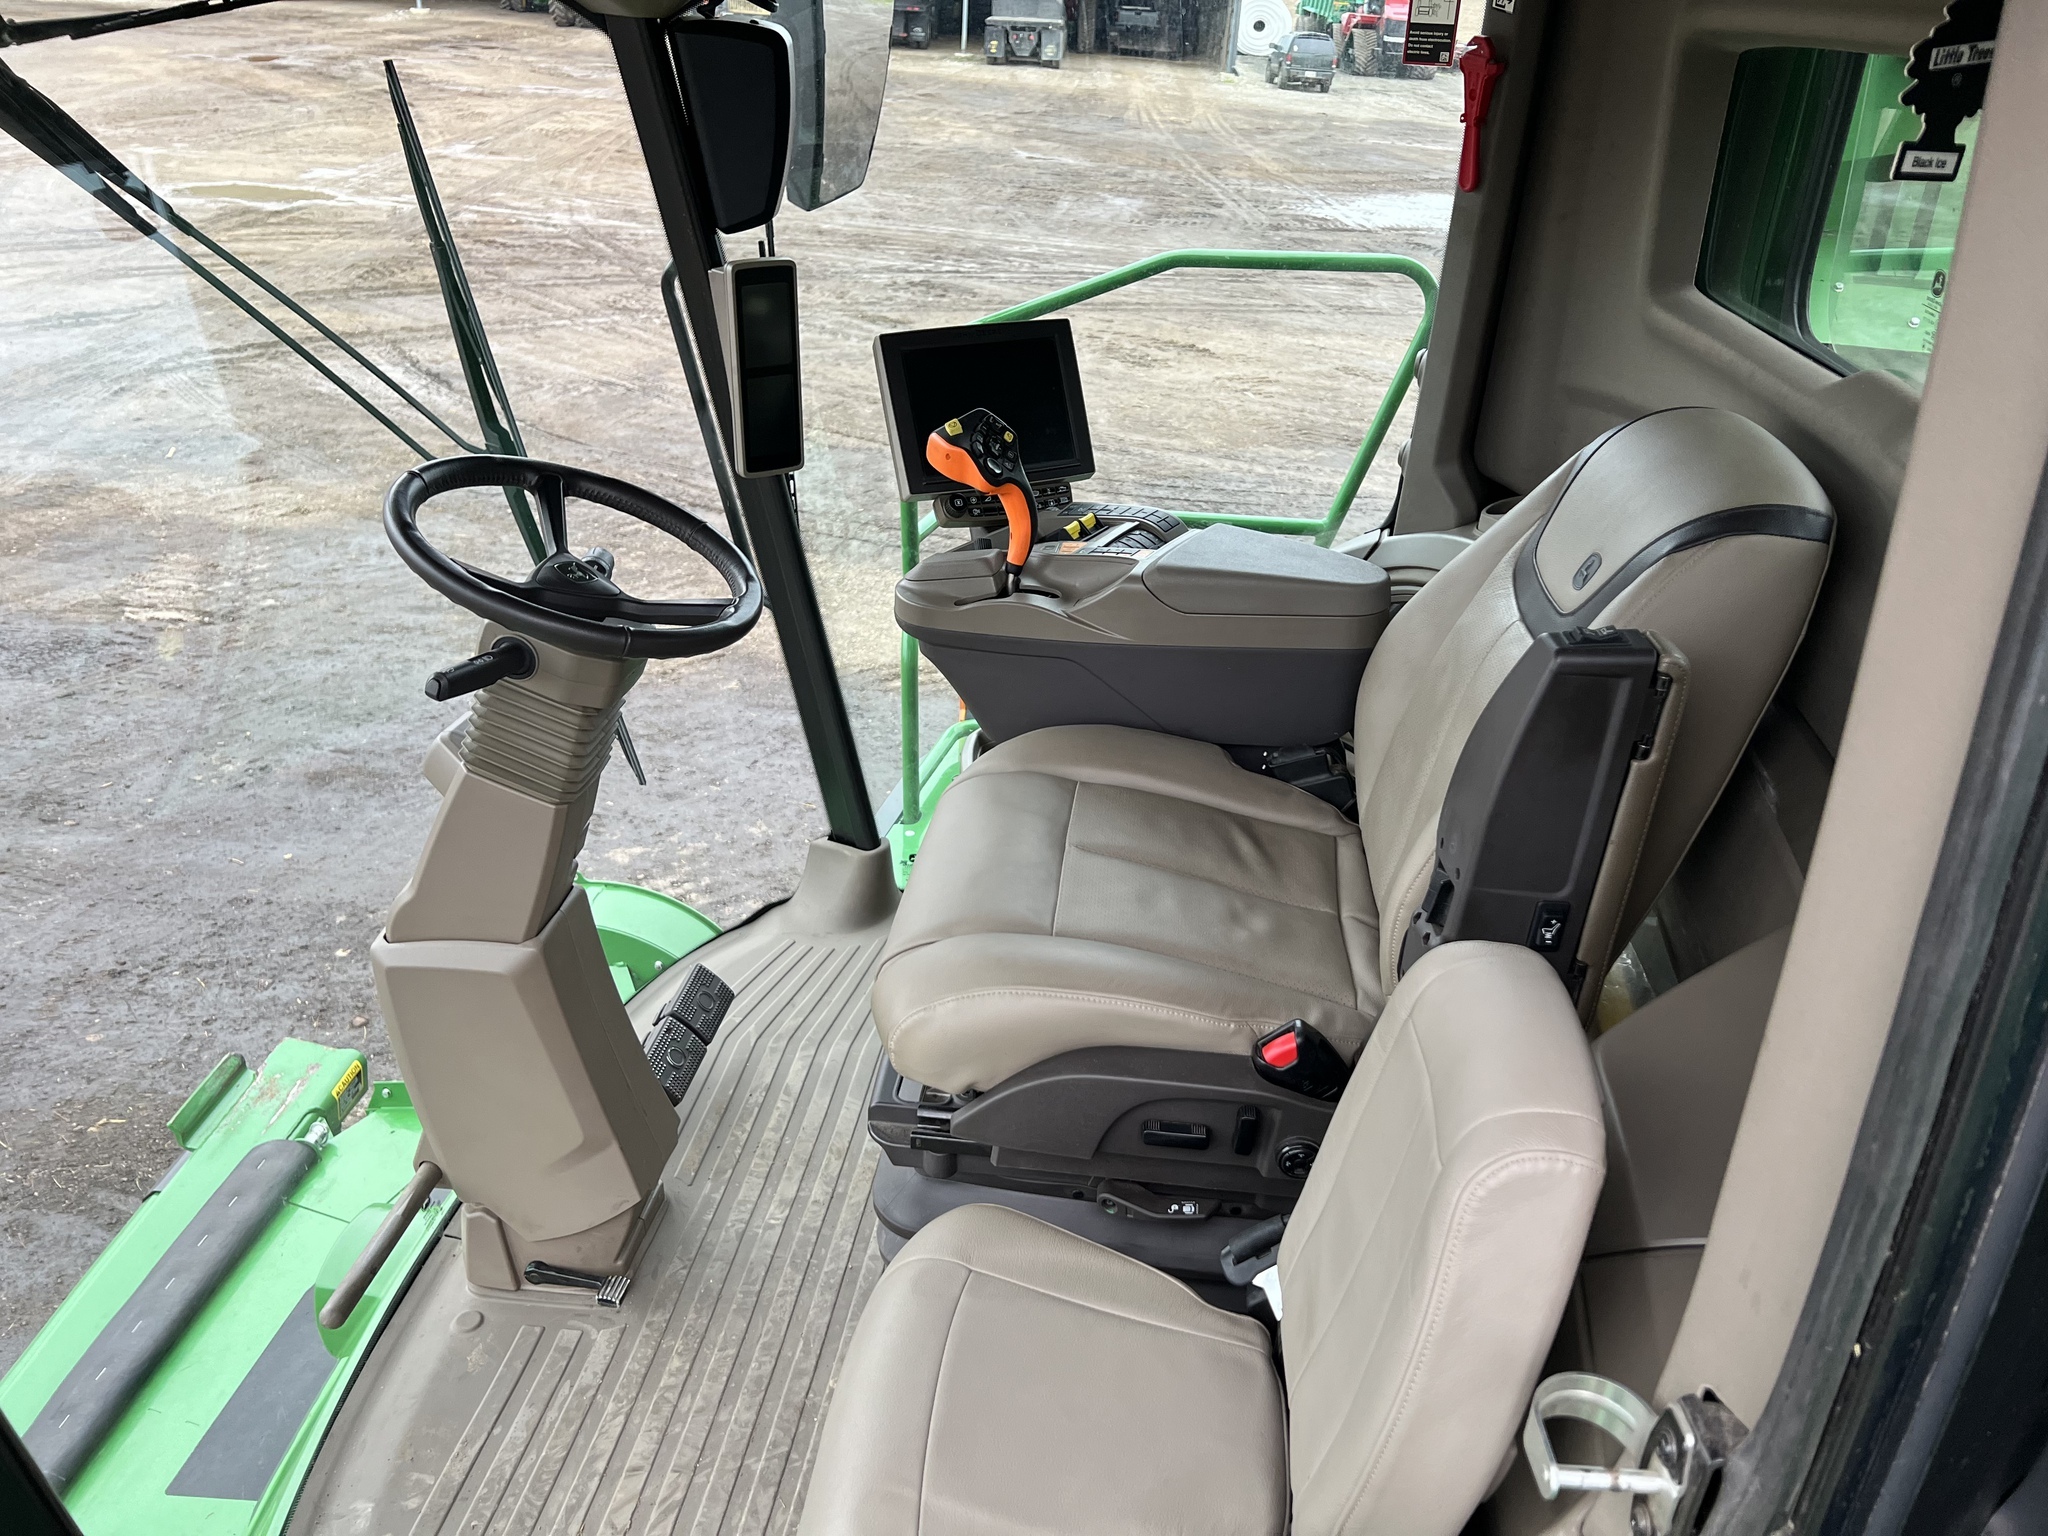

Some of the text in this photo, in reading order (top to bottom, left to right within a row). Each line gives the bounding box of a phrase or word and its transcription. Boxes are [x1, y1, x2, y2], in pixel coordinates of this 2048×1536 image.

[1934, 46, 1964, 66] Little
[1911, 155, 1947, 169] Black Ice
[338, 1063, 360, 1091] CAUTION
